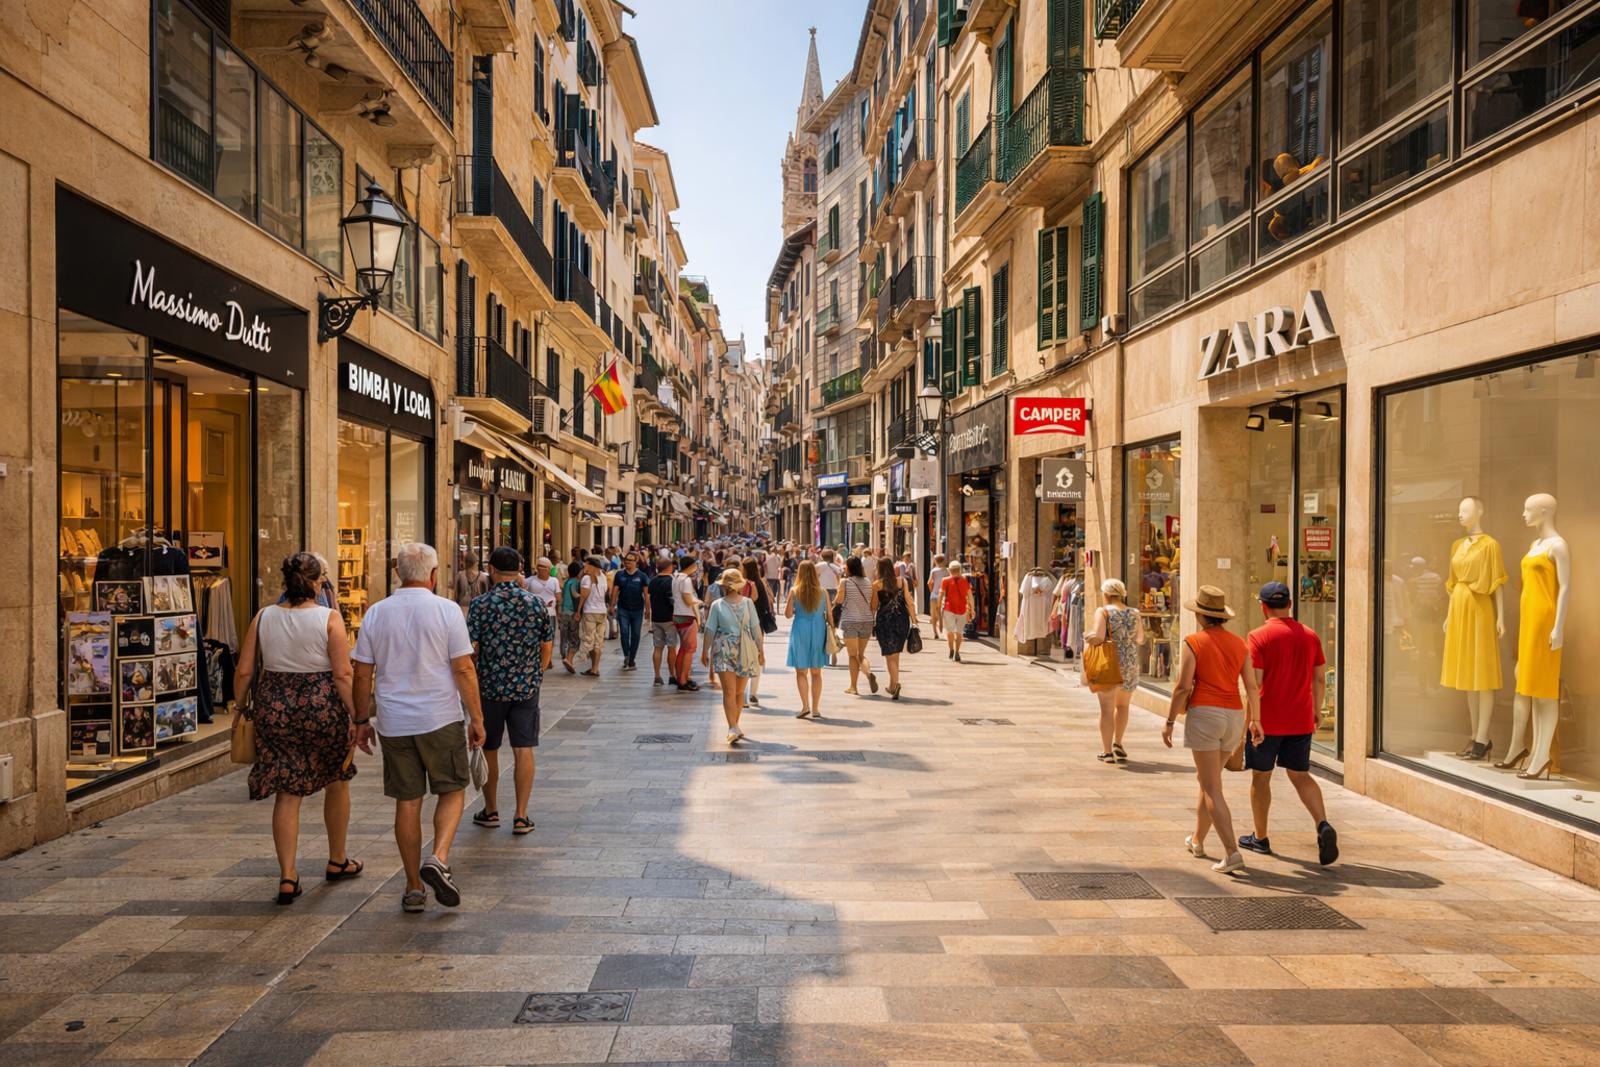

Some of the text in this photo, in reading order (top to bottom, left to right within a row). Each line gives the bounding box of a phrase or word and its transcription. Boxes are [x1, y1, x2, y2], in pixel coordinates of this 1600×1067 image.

[131, 259, 272, 353] Massimo Dutti
[1197, 289, 1336, 381] ZARA
[348, 362, 391, 405] BIMBA
[1020, 406, 1081, 423] CAMPER
